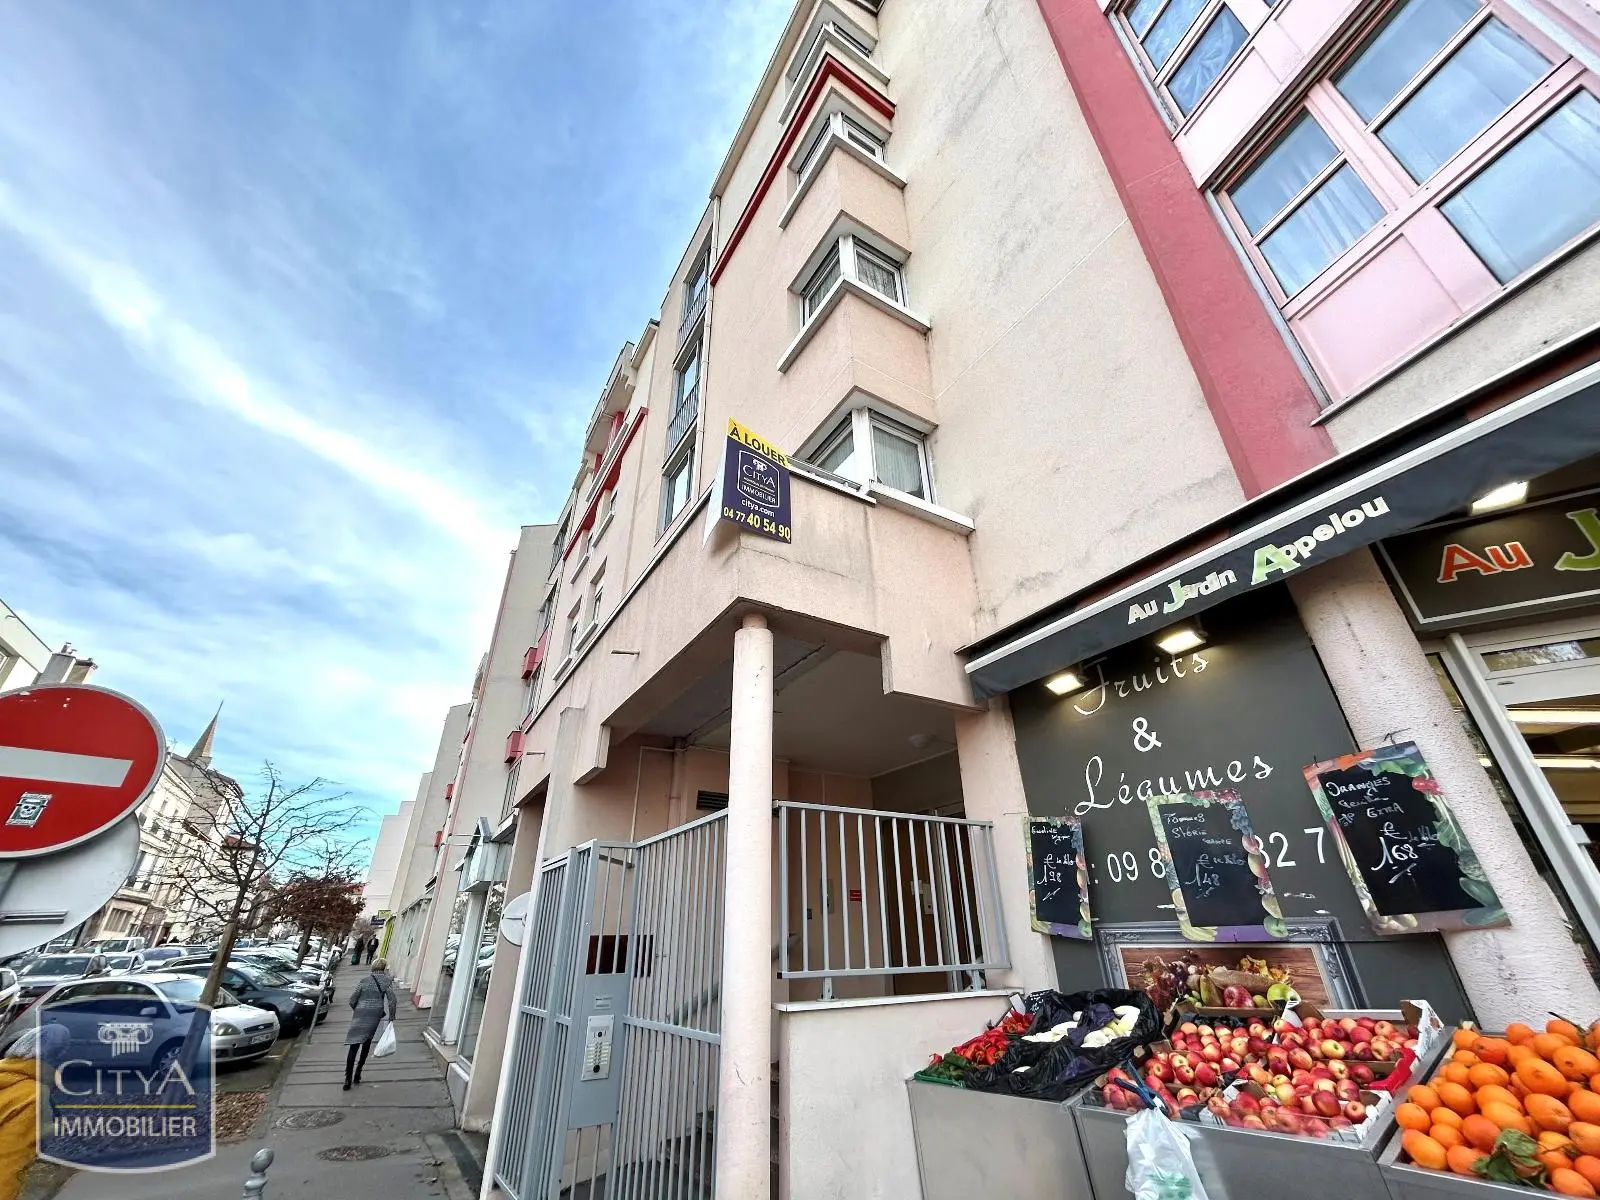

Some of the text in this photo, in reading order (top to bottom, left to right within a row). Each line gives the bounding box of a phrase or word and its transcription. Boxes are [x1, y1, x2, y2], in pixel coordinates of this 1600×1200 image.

[730, 421, 787, 466] À LOUER
[741, 484, 776, 504] IMMOBILIER
[741, 499, 775, 517] citya.com
[723, 506, 791, 541] 04 77 40 54 90
[1127, 496, 1390, 625] Au Jardin Appelou
[1437, 541, 1535, 583] Au
[1073, 651, 1209, 715] Fruits
[1132, 717, 1162, 752] &
[1107, 850, 1138, 882] 09
